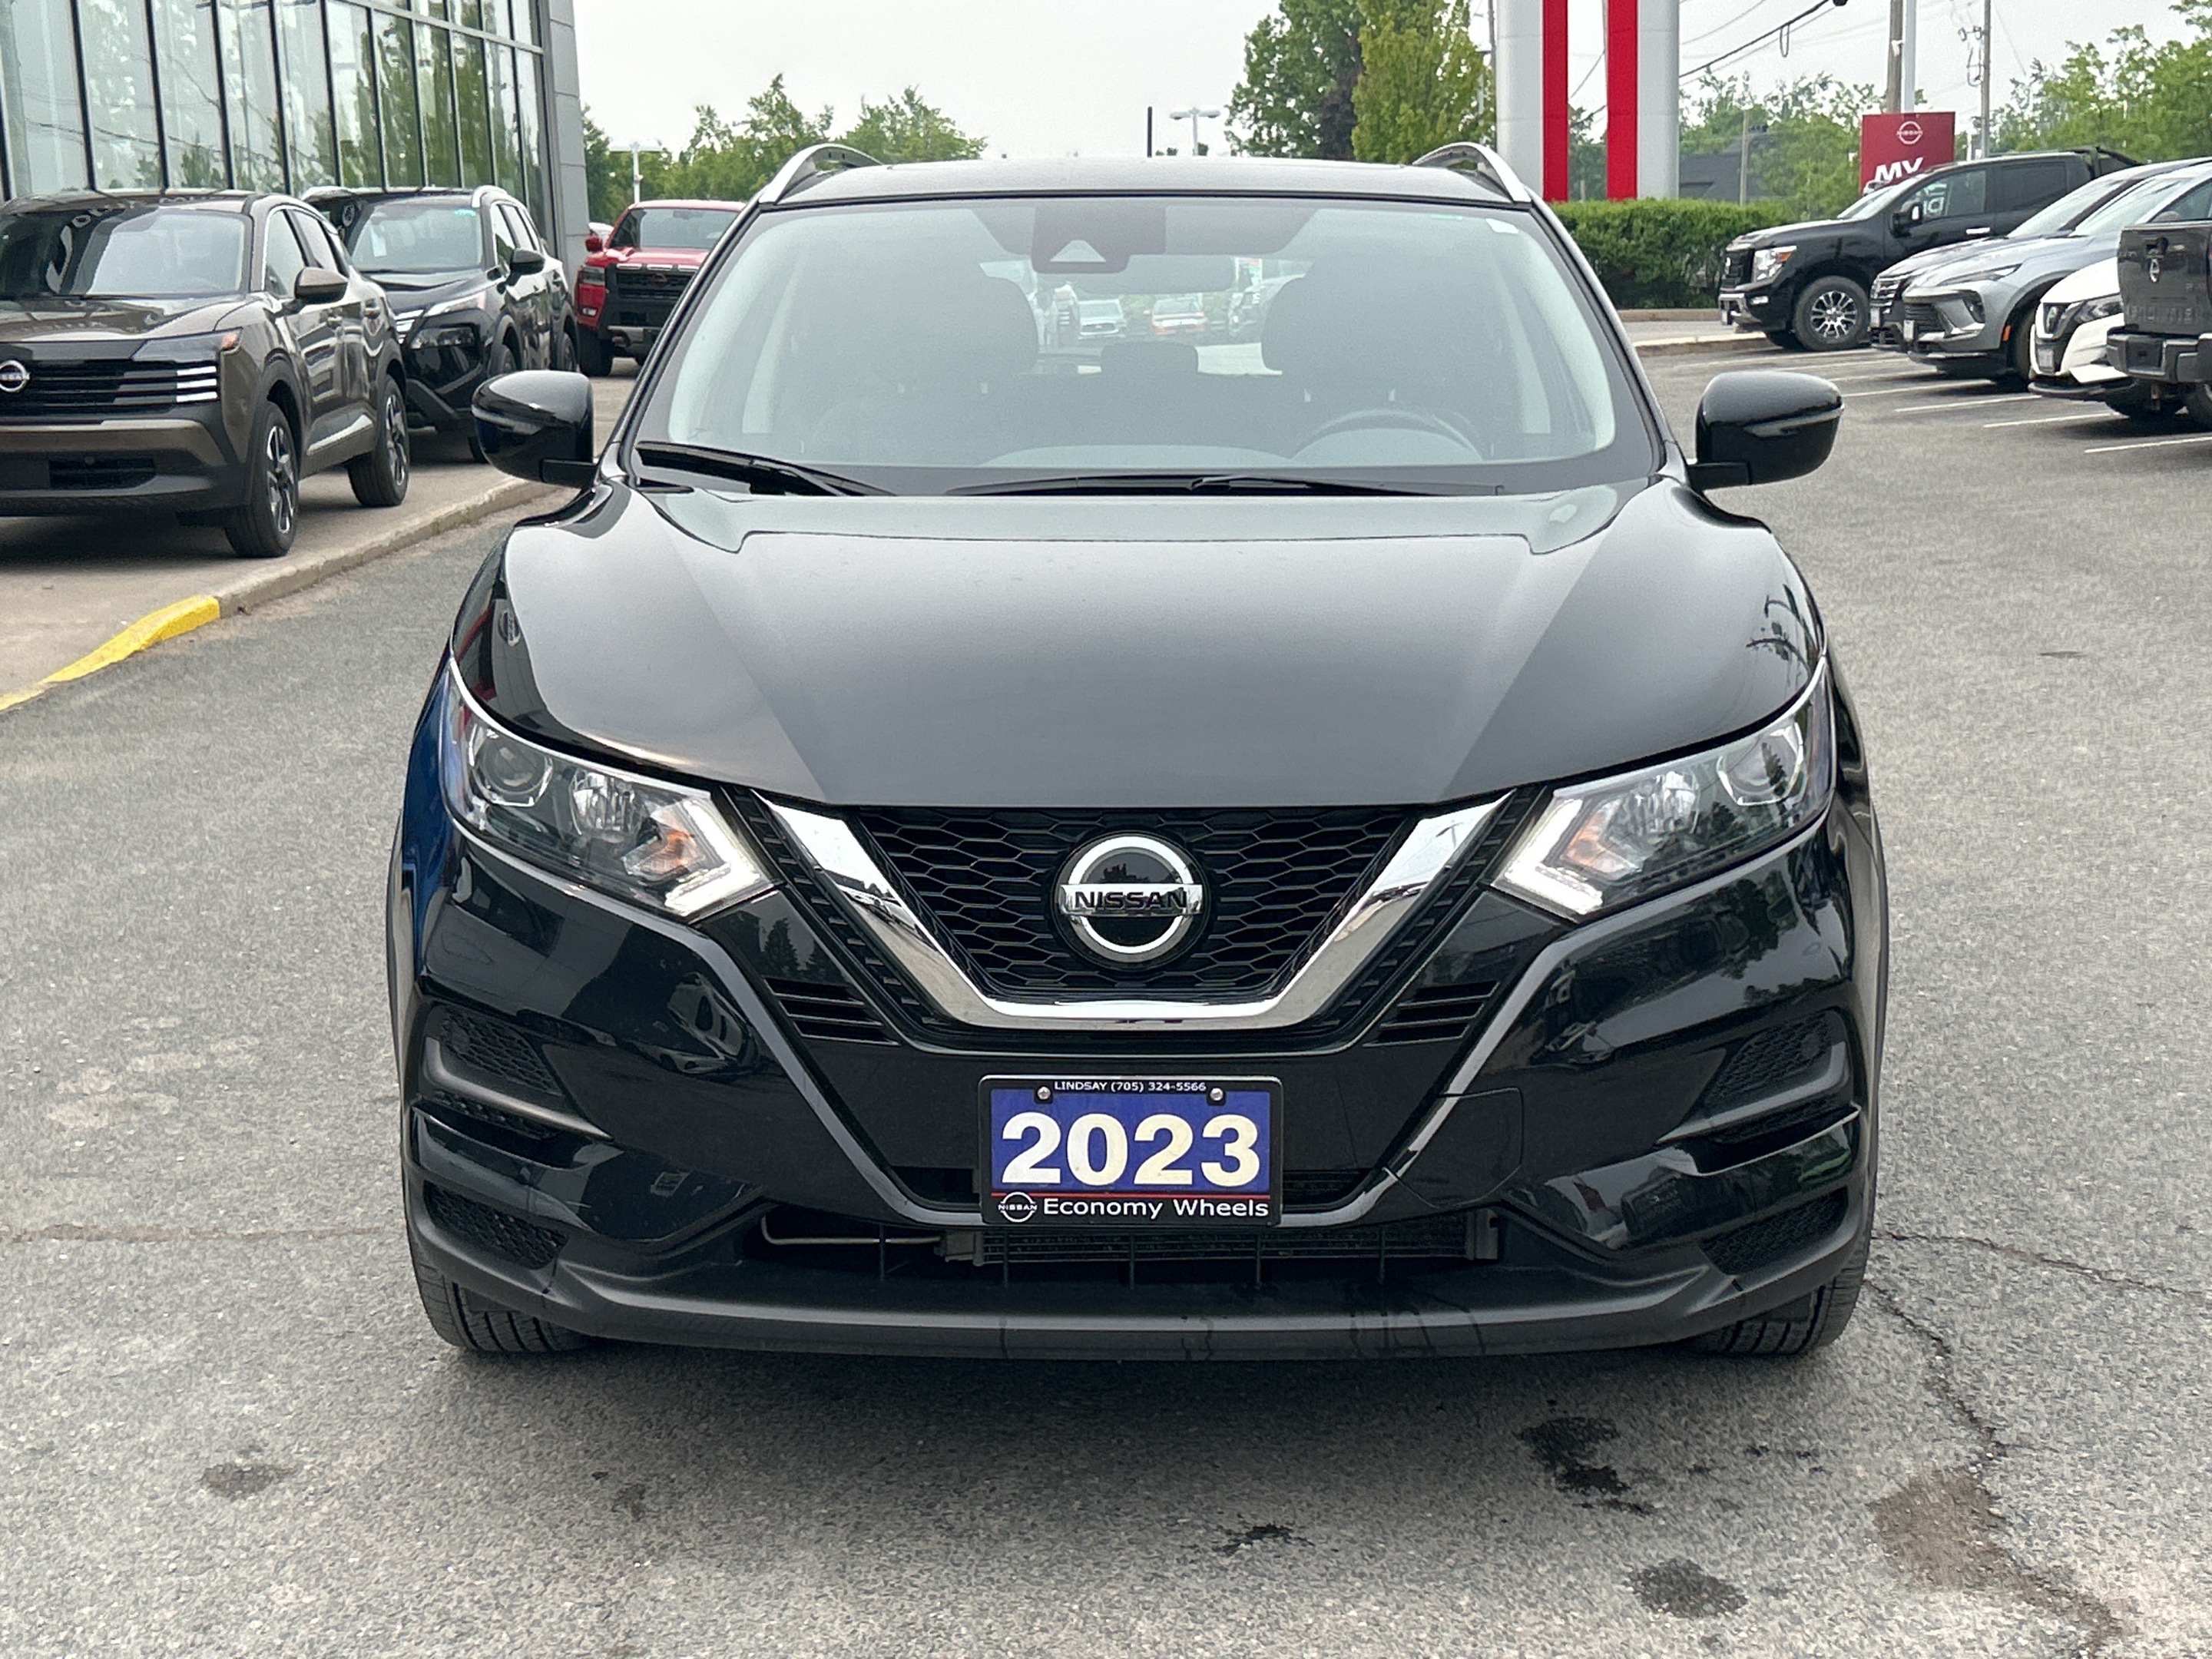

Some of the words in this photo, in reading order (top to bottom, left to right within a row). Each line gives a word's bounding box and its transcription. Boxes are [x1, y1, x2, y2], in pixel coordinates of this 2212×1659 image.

[1075, 892, 1187, 909] NISSAN
[1054, 1081, 1108, 1091] LINDSAY
[1111, 1081, 1144, 1092] (705)
[1148, 1081, 1207, 1091] 324-5566
[1002, 1111, 1260, 1187] 2023
[1044, 1198, 1164, 1220] Economy
[1172, 1199, 1269, 1217] Wheels
